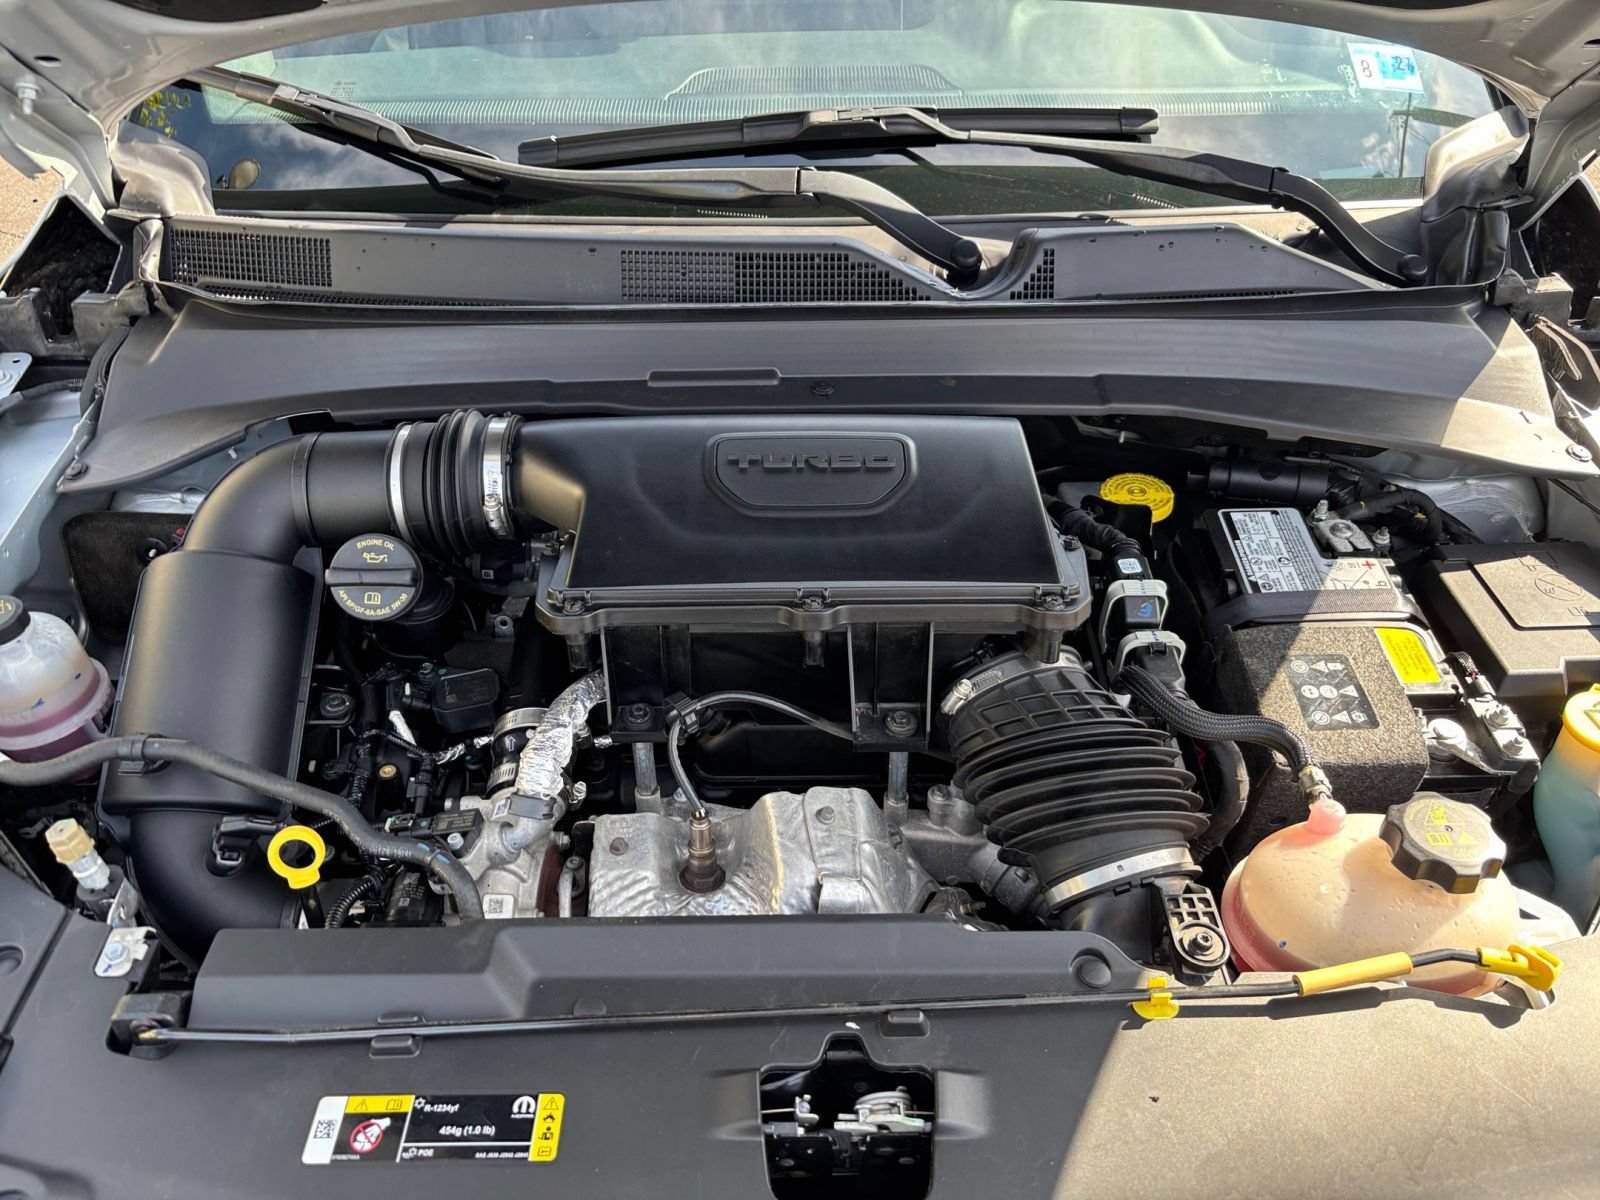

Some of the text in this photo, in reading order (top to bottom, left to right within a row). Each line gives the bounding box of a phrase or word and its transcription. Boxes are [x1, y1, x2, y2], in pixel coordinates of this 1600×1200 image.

[1360, 60, 1372, 78] 8
[727, 453, 897, 473] TURBO
[356, 539, 395, 551] ENGINE OIL
[338, 590, 349, 601] API
[424, 1104, 459, 1114] R-1234yf
[439, 1125, 496, 1137] 454g (1.0 lb)
[418, 1149, 434, 1157] POE
